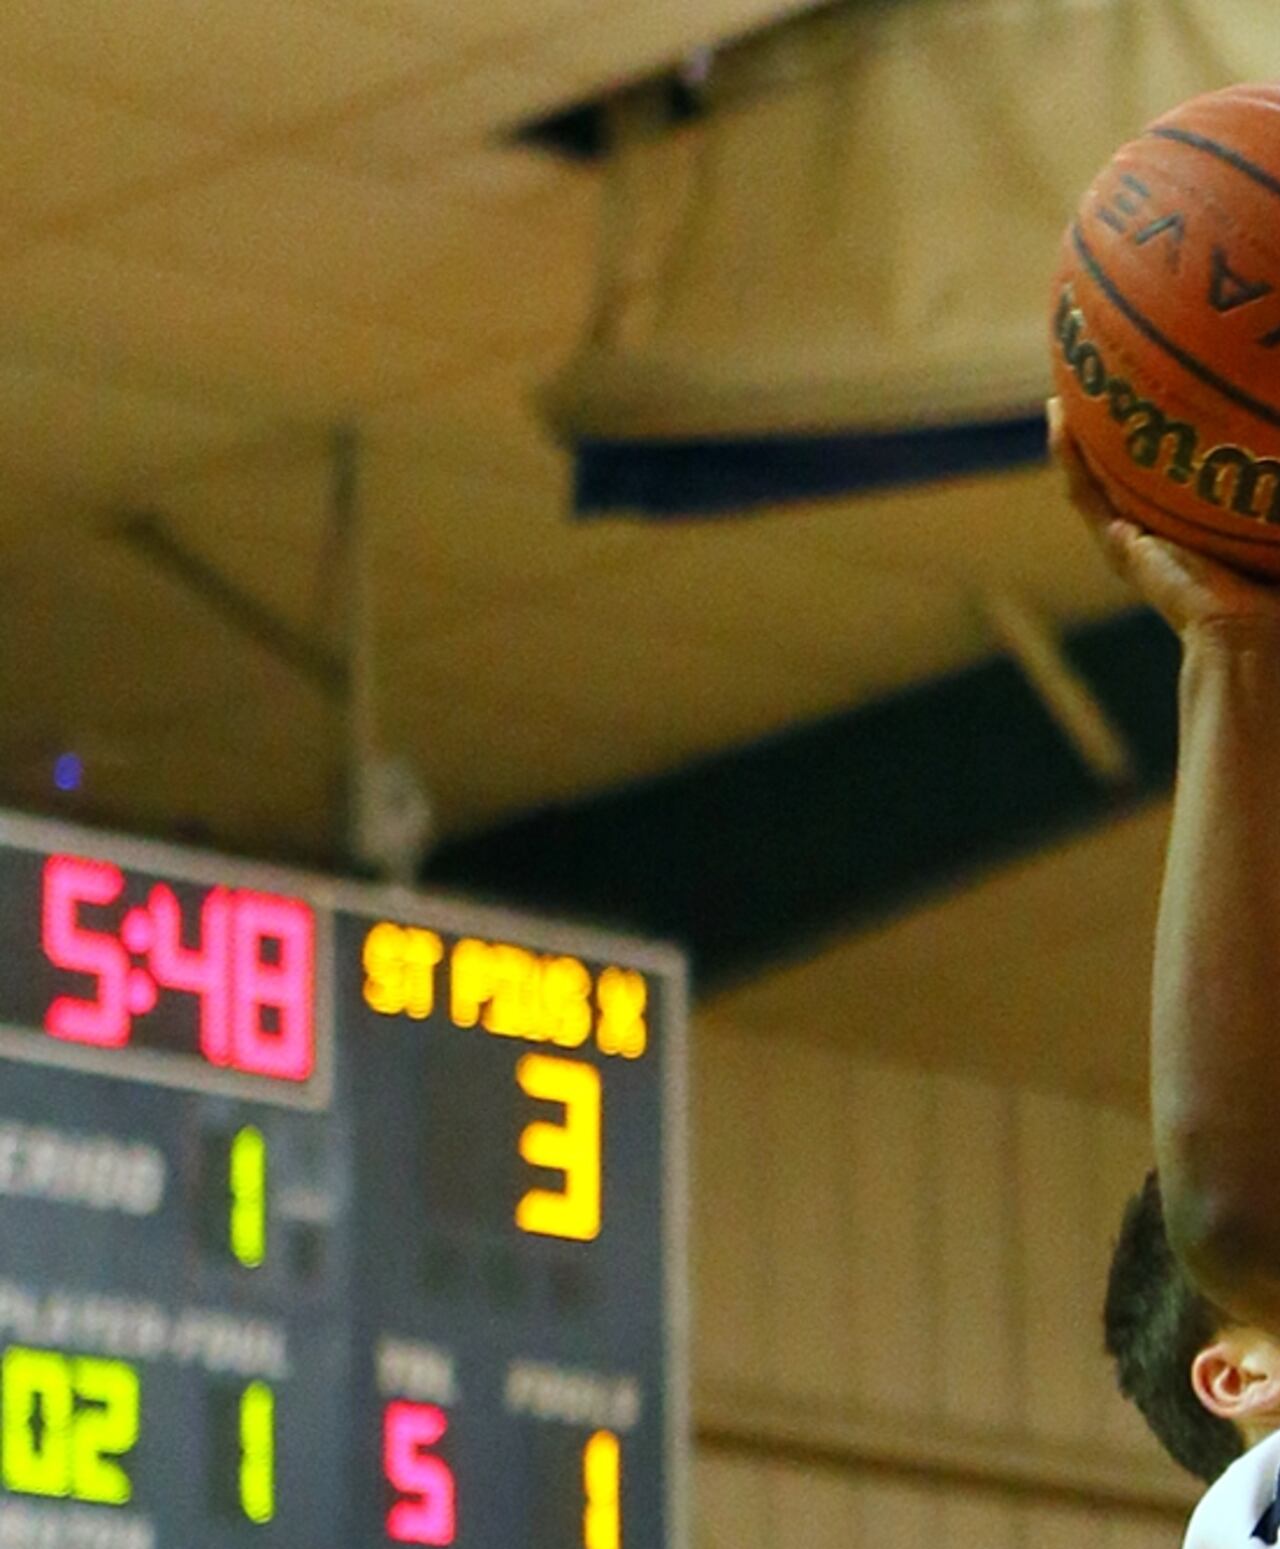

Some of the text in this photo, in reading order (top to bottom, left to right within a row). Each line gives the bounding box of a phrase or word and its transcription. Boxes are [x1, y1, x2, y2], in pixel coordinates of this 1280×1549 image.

[41, 853, 315, 1082] 5:48
[230, 1125, 266, 1268] 1
[515, 1052, 602, 1244] 3
[240, 1380, 275, 1524] 1
[384, 1399, 458, 1548] 5
